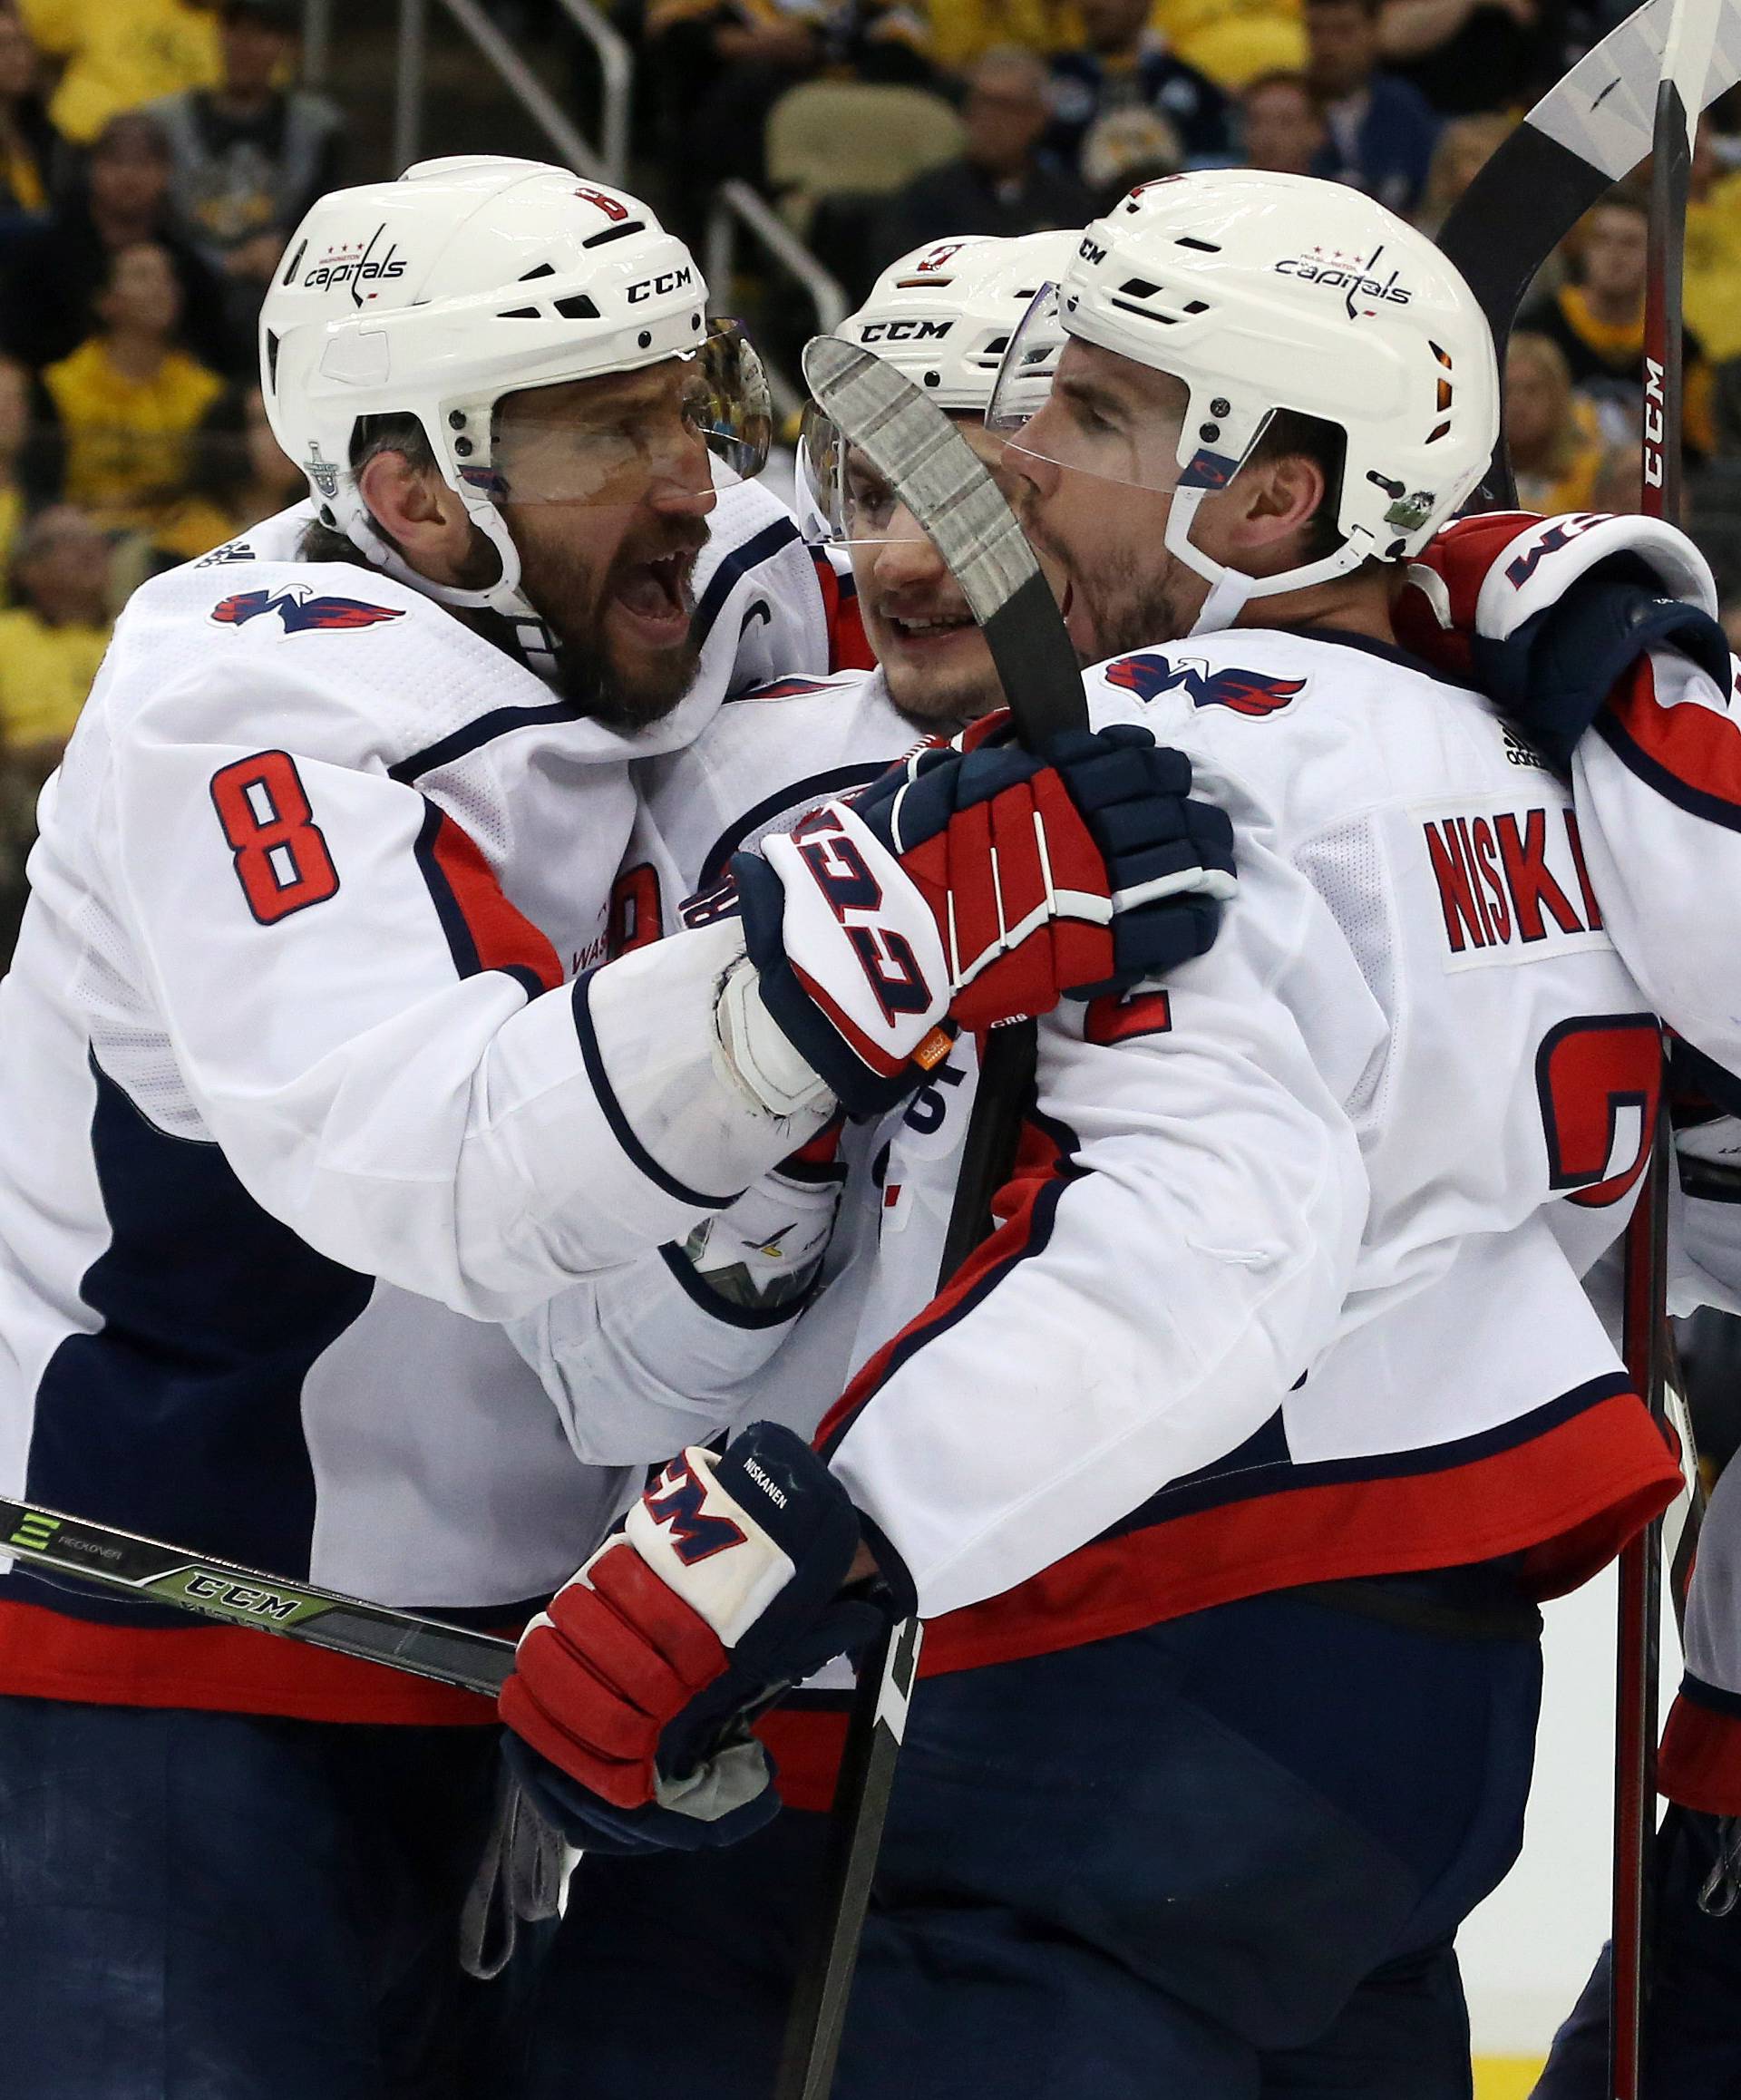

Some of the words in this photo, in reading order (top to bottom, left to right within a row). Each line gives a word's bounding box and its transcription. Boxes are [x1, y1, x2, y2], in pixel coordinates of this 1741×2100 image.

[305, 223, 407, 308] capitals
[626, 267, 692, 304] CCM
[1274, 245, 1412, 319] capitals
[861, 322, 954, 343] CCM
[1645, 356, 1664, 489] CCM
[209, 749, 341, 926] 8
[743, 1457, 789, 1510] NISKANEN
[184, 1571, 303, 1621] CCM
